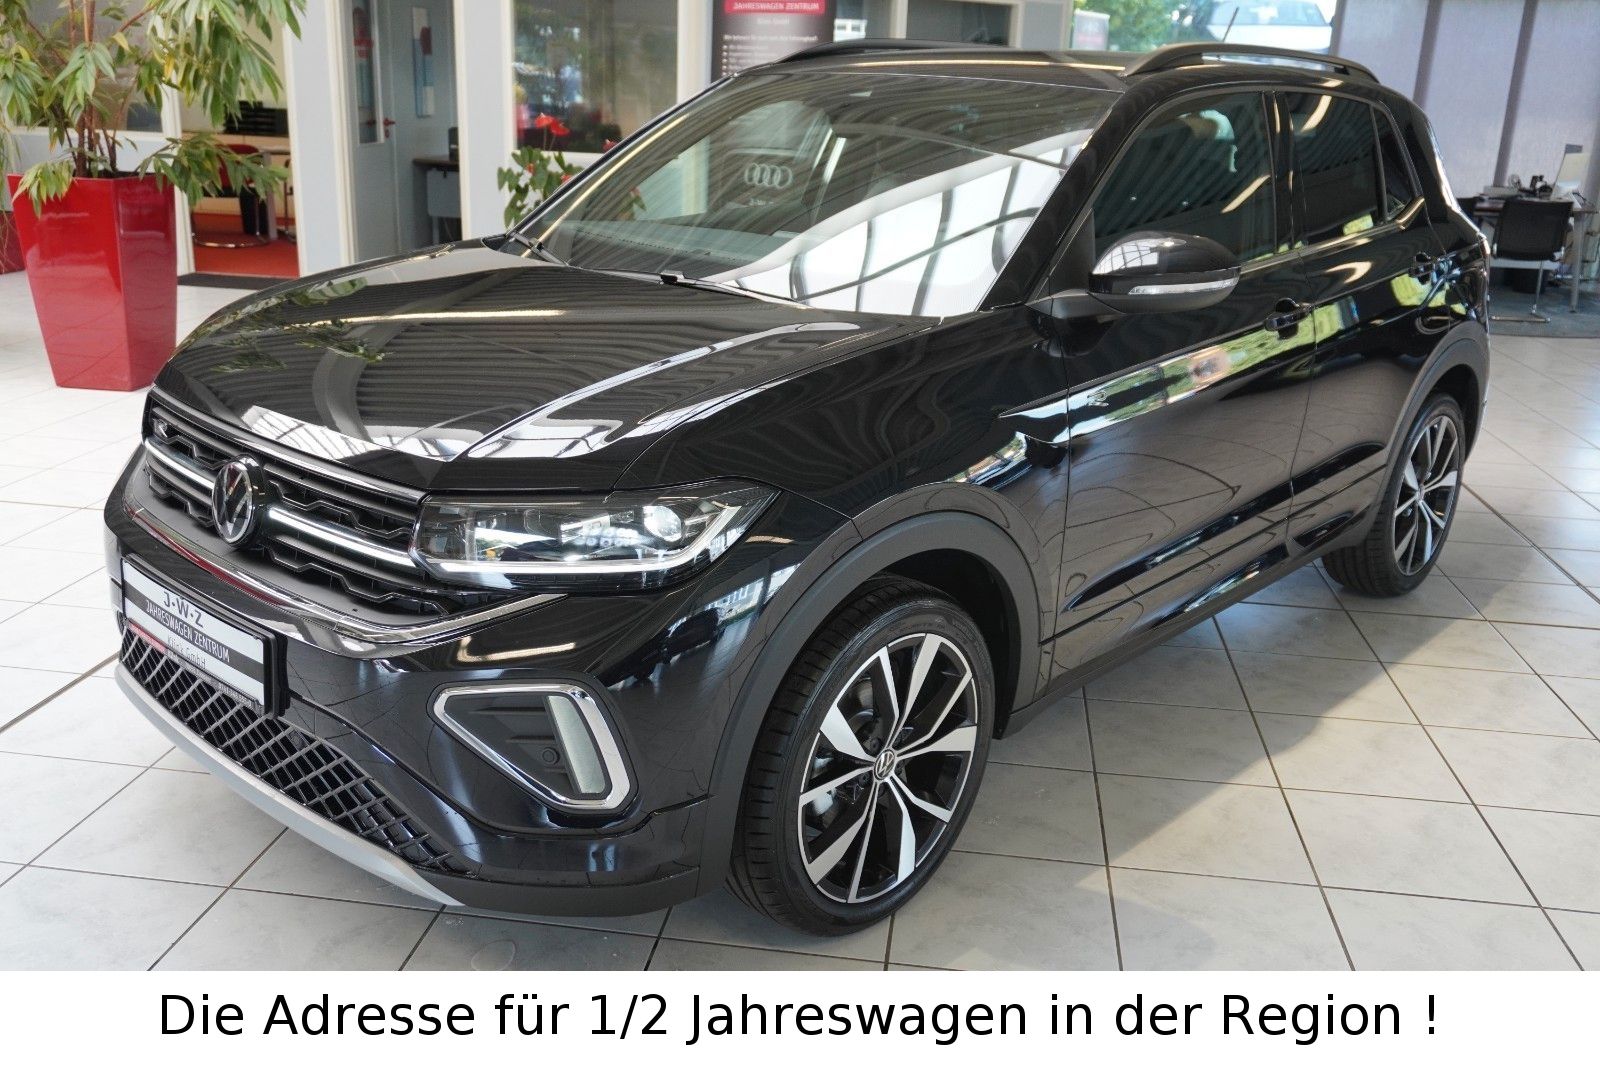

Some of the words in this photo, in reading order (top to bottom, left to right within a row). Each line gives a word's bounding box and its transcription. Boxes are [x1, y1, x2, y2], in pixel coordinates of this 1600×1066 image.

[733, 1, 784, 11] JAHRESWAGEN
[785, 1, 820, 11] ZENTRUM
[146, 600, 194, 642] JAHRESWAGEN
[193, 633, 230, 663] ZENTRUM
